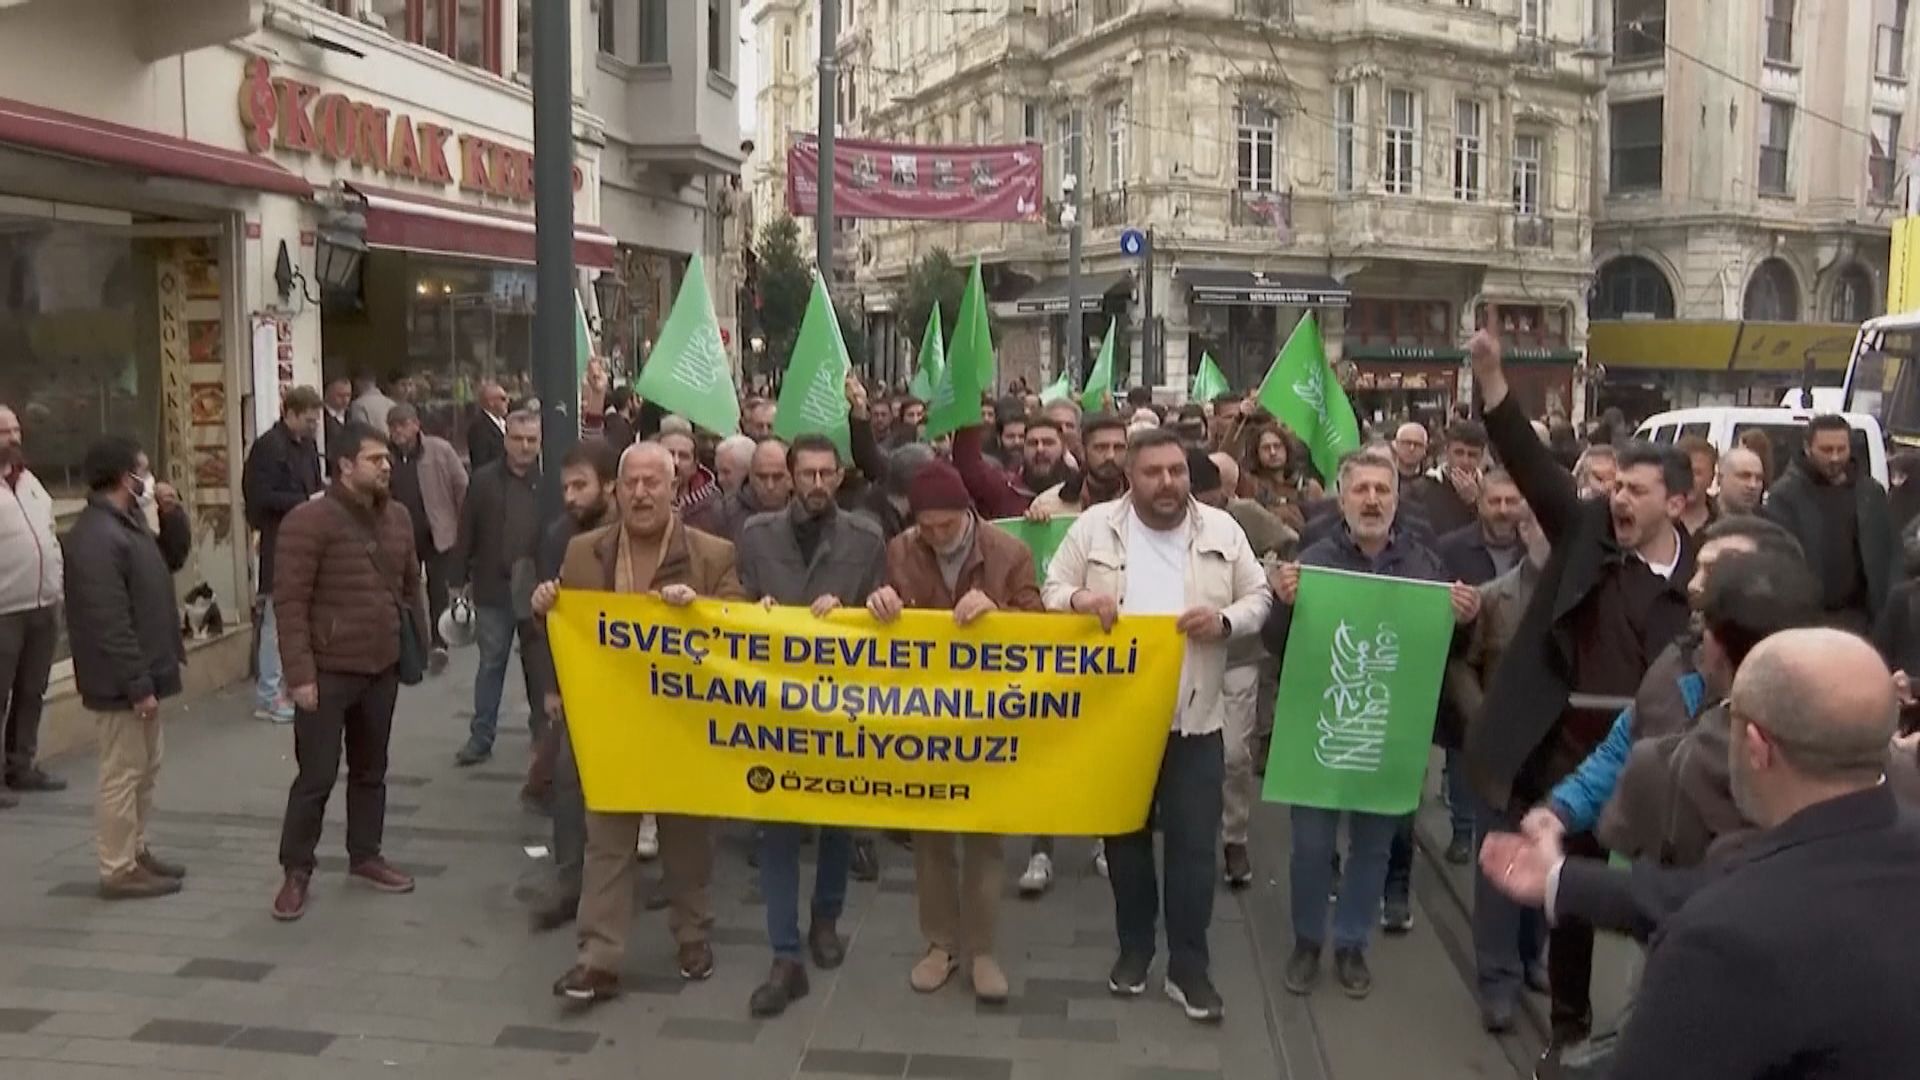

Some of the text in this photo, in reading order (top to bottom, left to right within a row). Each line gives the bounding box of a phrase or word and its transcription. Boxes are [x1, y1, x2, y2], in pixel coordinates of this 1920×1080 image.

[273, 76, 454, 185] KONAK
[784, 635, 936, 668] DEVLET
[950, 637, 1137, 674] DESTEKLİ
[650, 662, 1081, 723] İSLAM DÜŞMANLIĞINI
[709, 720, 1019, 763] LANETLİYORUZ!
[781, 770, 970, 800] ÖZGÜR-DER
